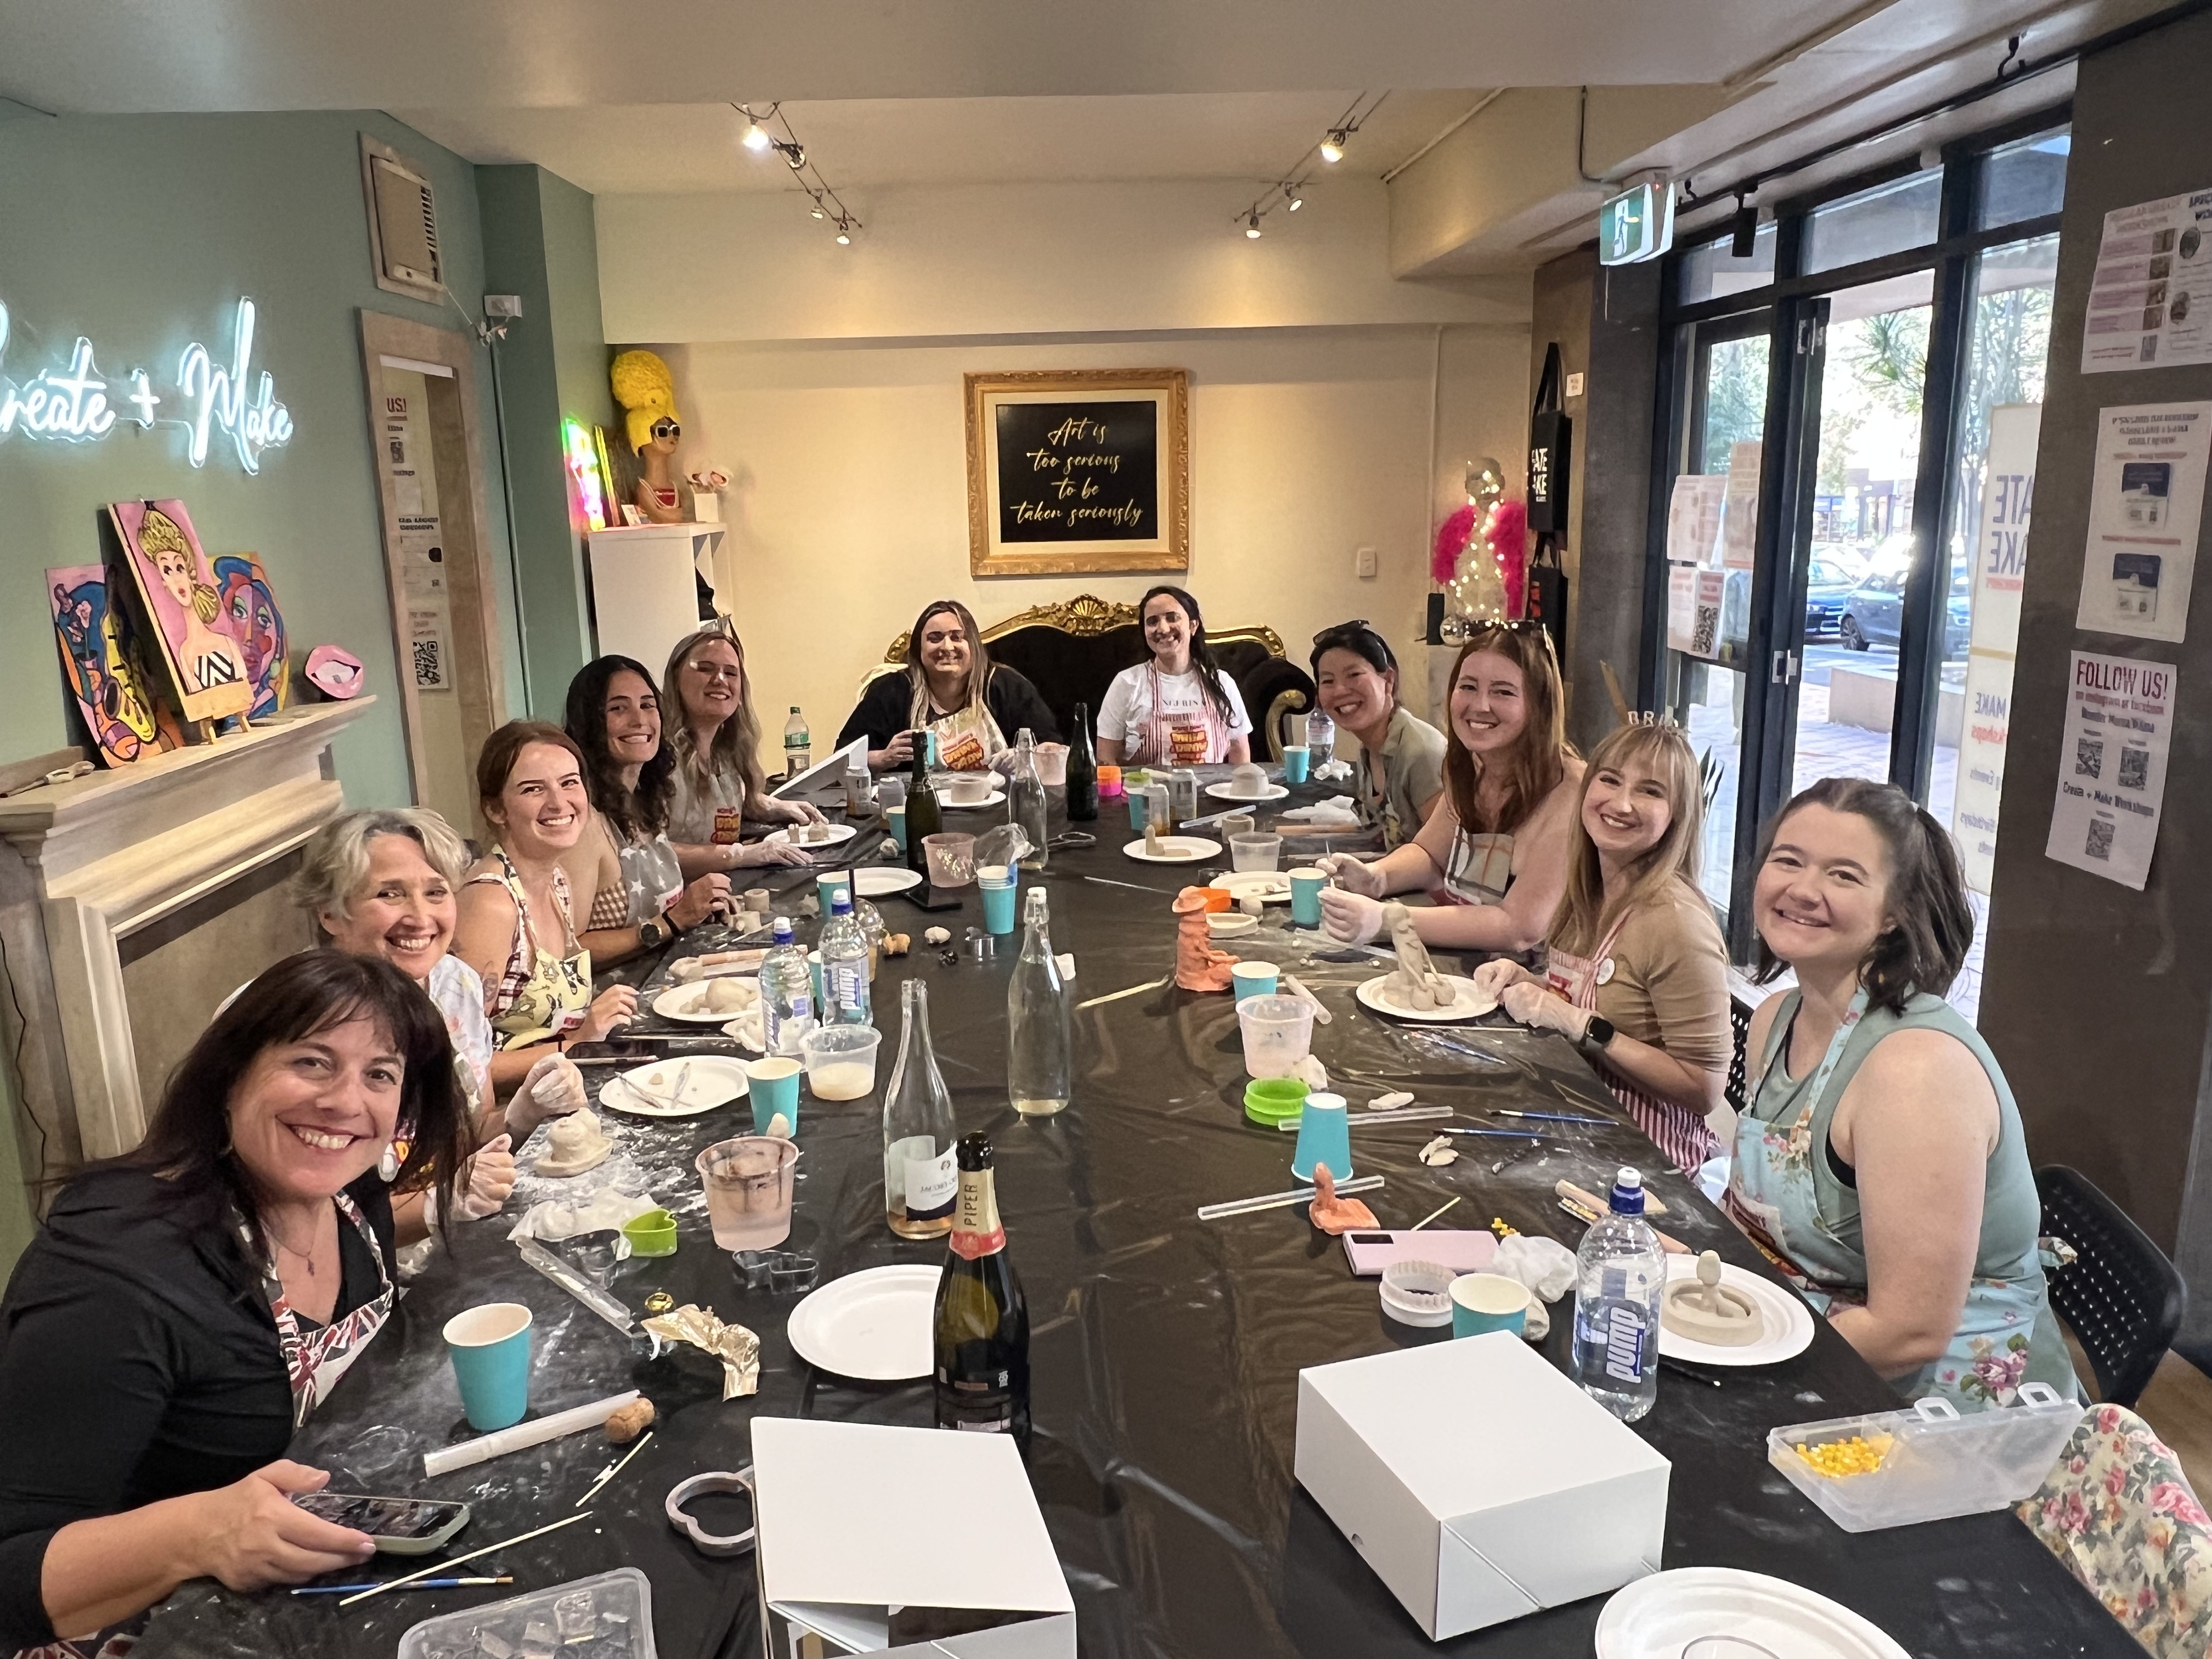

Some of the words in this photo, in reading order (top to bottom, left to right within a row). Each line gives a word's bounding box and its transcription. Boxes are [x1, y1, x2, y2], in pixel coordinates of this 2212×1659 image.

[0, 301, 116, 437] reate
[178, 297, 293, 473] Make
[1048, 417, 1093, 447] Art
[1092, 424, 1107, 444] is
[1026, 448, 1060, 471] too
[1064, 453, 1120, 474] serious
[1051, 477, 1076, 500] to
[1081, 477, 1099, 500] be
[1010, 500, 1062, 524] taken
[1067, 498, 1143, 527] seriously
[2076, 659, 2137, 695] FOLLOW
[2142, 670, 2168, 700] US!
[838, 967, 860, 1010] pump
[964, 1184, 978, 1227] PIPER
[1606, 1309, 1646, 1384] pump
